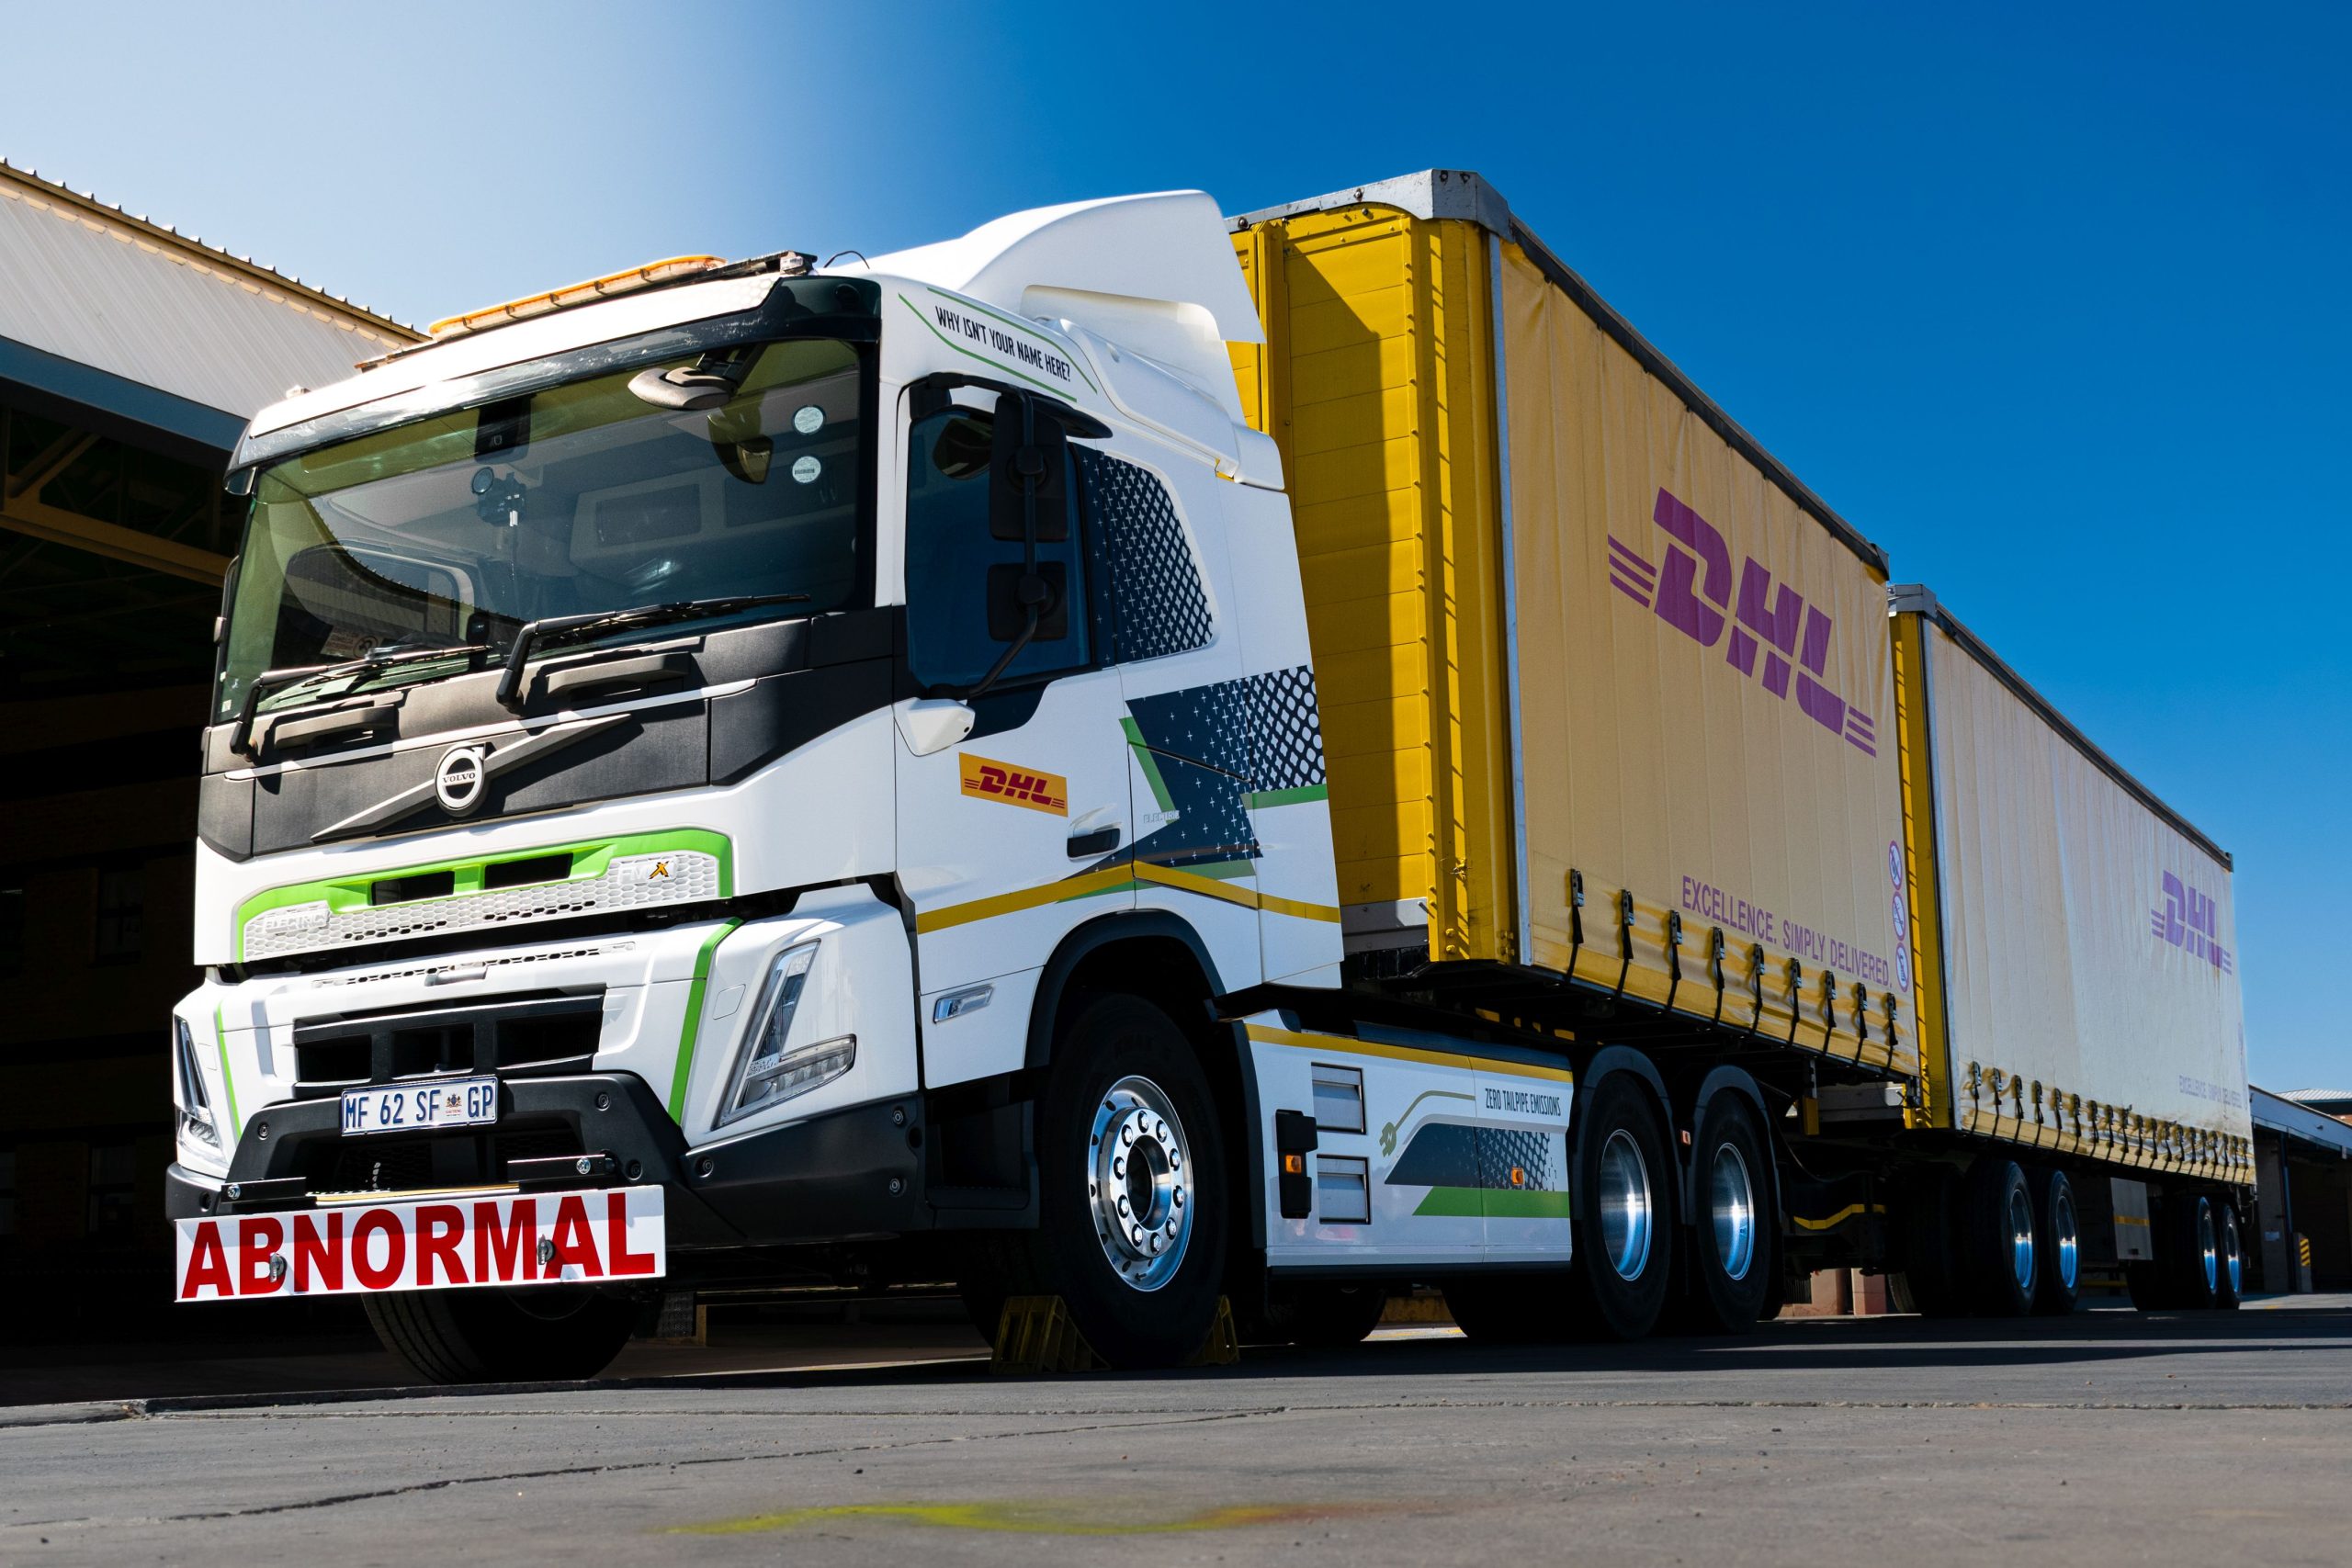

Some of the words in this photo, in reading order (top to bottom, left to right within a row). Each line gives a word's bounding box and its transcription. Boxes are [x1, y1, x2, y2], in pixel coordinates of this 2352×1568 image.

[935, 305, 960, 333] WHY
[963, 317, 987, 344] ISN'T
[989, 328, 1015, 357] YOUR
[1016, 341, 1044, 369] NAME
[1045, 353, 1071, 382] HERE?
[1653, 486, 1846, 736] DHL
[443, 773, 476, 784] VOLVO
[979, 765, 1052, 806] DHL
[619, 861, 670, 883] FMX
[265, 913, 326, 929] ELECTRIC
[1682, 875, 1777, 944] EXCELLENCE.
[1783, 919, 1826, 962] SIMPLY
[1830, 938, 1893, 988] DELIVERED.
[2162, 869, 2223, 970] DHL
[345, 1097, 369, 1128] MF
[379, 1093, 403, 1125] 62
[416, 1089, 440, 1122] SF
[468, 1085, 493, 1118] GP
[1485, 1088, 1501, 1111] ZERO
[1502, 1090, 1530, 1113] TAILPIPE
[1530, 1093, 1561, 1116] EMISSIONS
[181, 1192, 656, 1299] ABNORMAL
